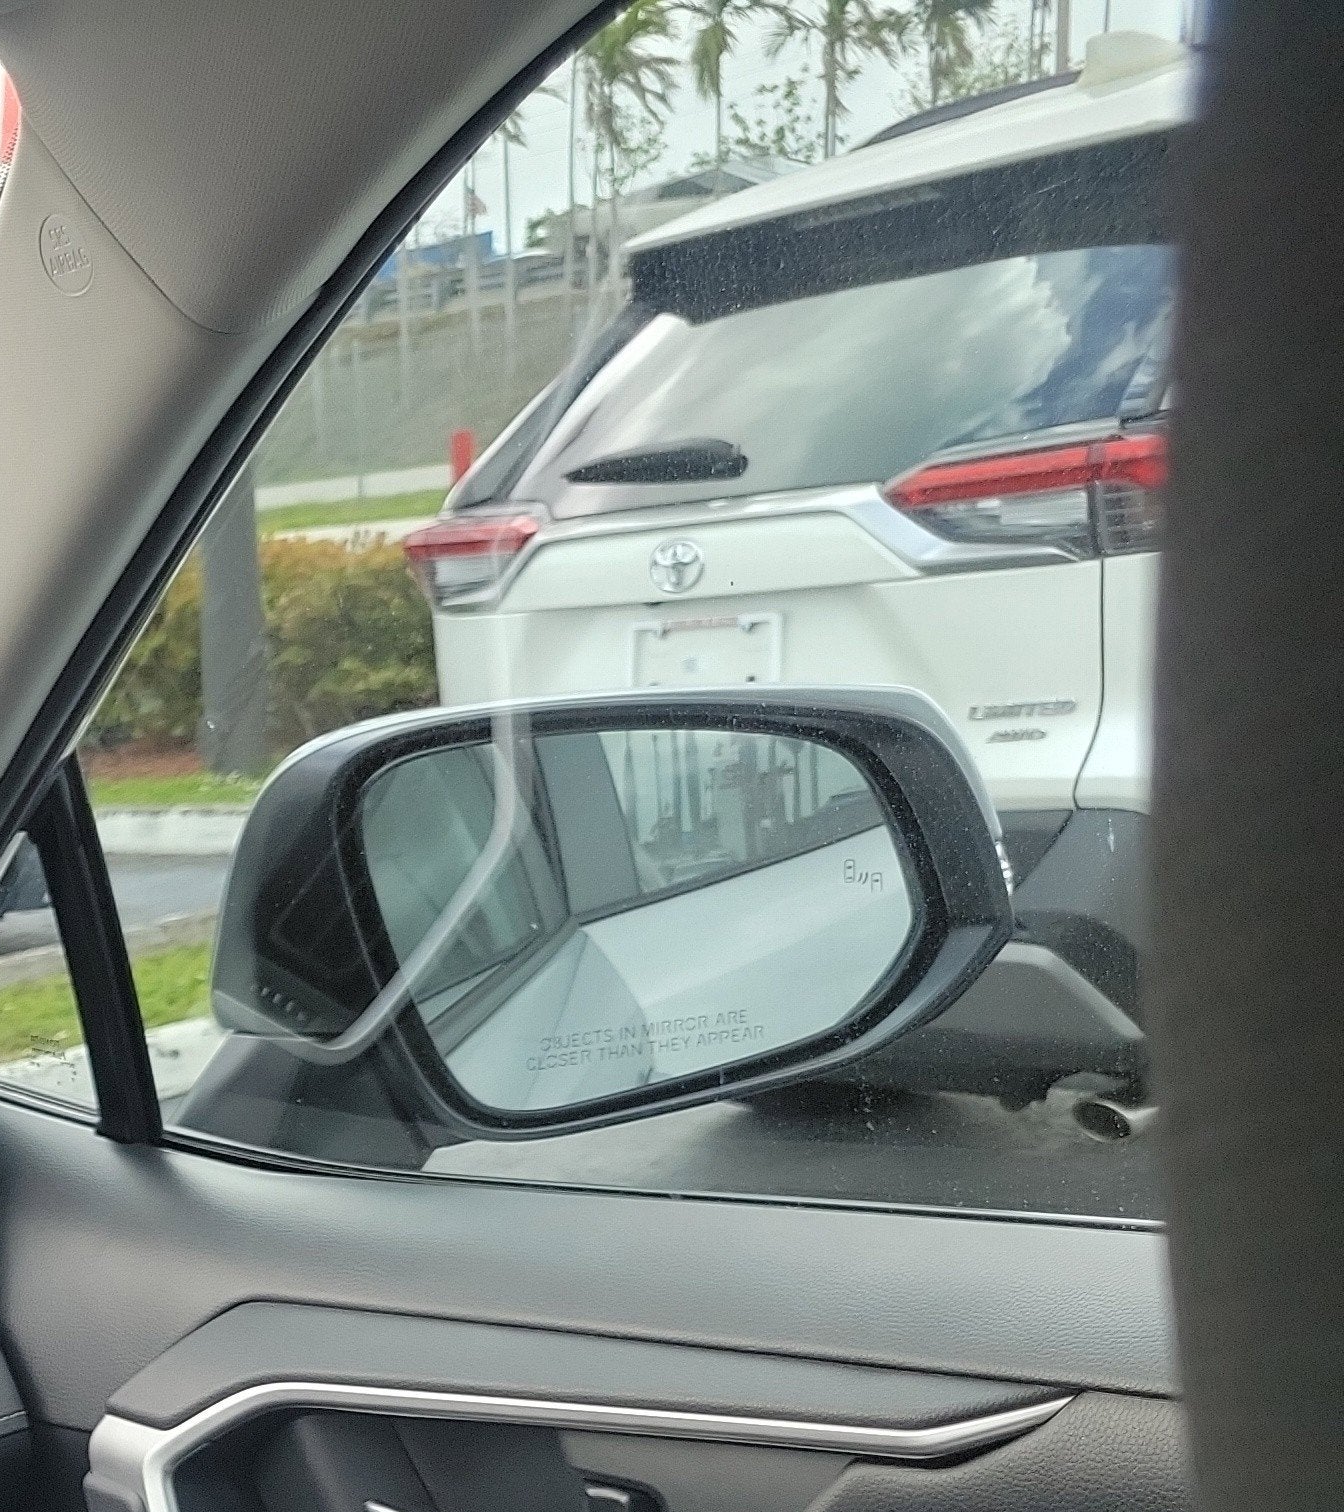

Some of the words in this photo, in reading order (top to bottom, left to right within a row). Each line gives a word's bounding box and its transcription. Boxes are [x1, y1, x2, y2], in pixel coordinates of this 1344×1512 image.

[525, 1050, 592, 1072] CLOSER
[598, 1043, 643, 1062] THAN
[647, 1035, 691, 1054] THEY
[696, 1025, 764, 1048] APPEAR
[539, 1028, 613, 1051] OBJECTS
[618, 1025, 636, 1040] IN
[641, 1014, 710, 1038] MIRROR
[714, 1009, 748, 1027] ARE
